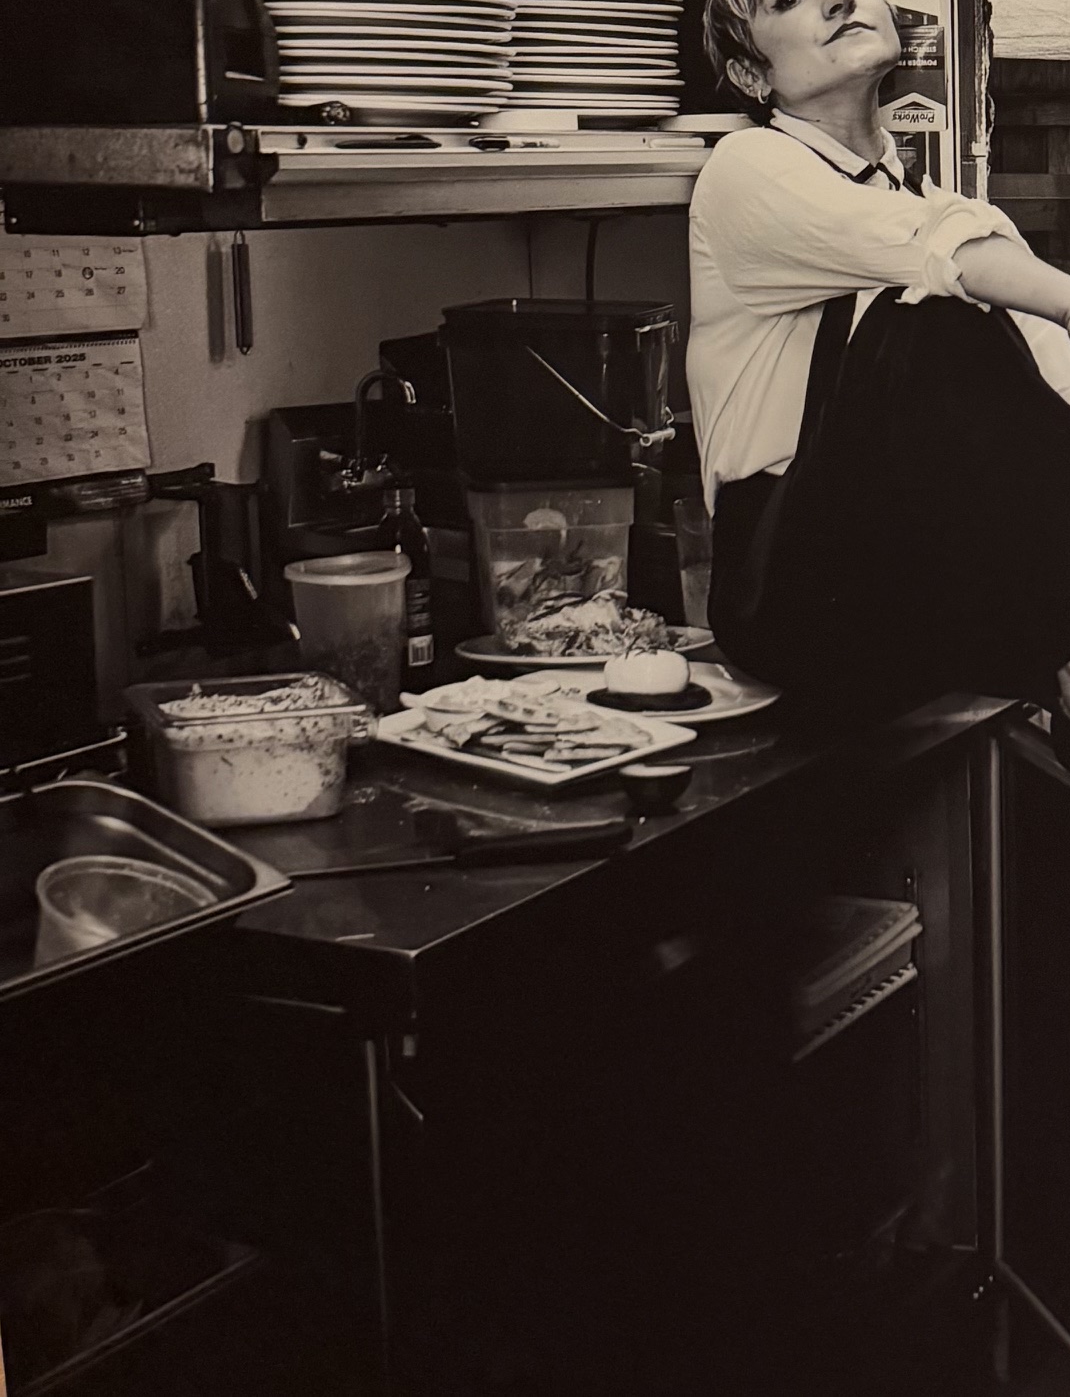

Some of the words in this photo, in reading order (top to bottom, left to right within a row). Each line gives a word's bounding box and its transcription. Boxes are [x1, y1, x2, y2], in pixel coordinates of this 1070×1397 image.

[892, 111, 935, 123] ProWorks
[115, 266, 125, 274] 20
[55, 289, 65, 298] 25
[117, 286, 126, 295] 27
[55, 353, 86, 364] 2025
